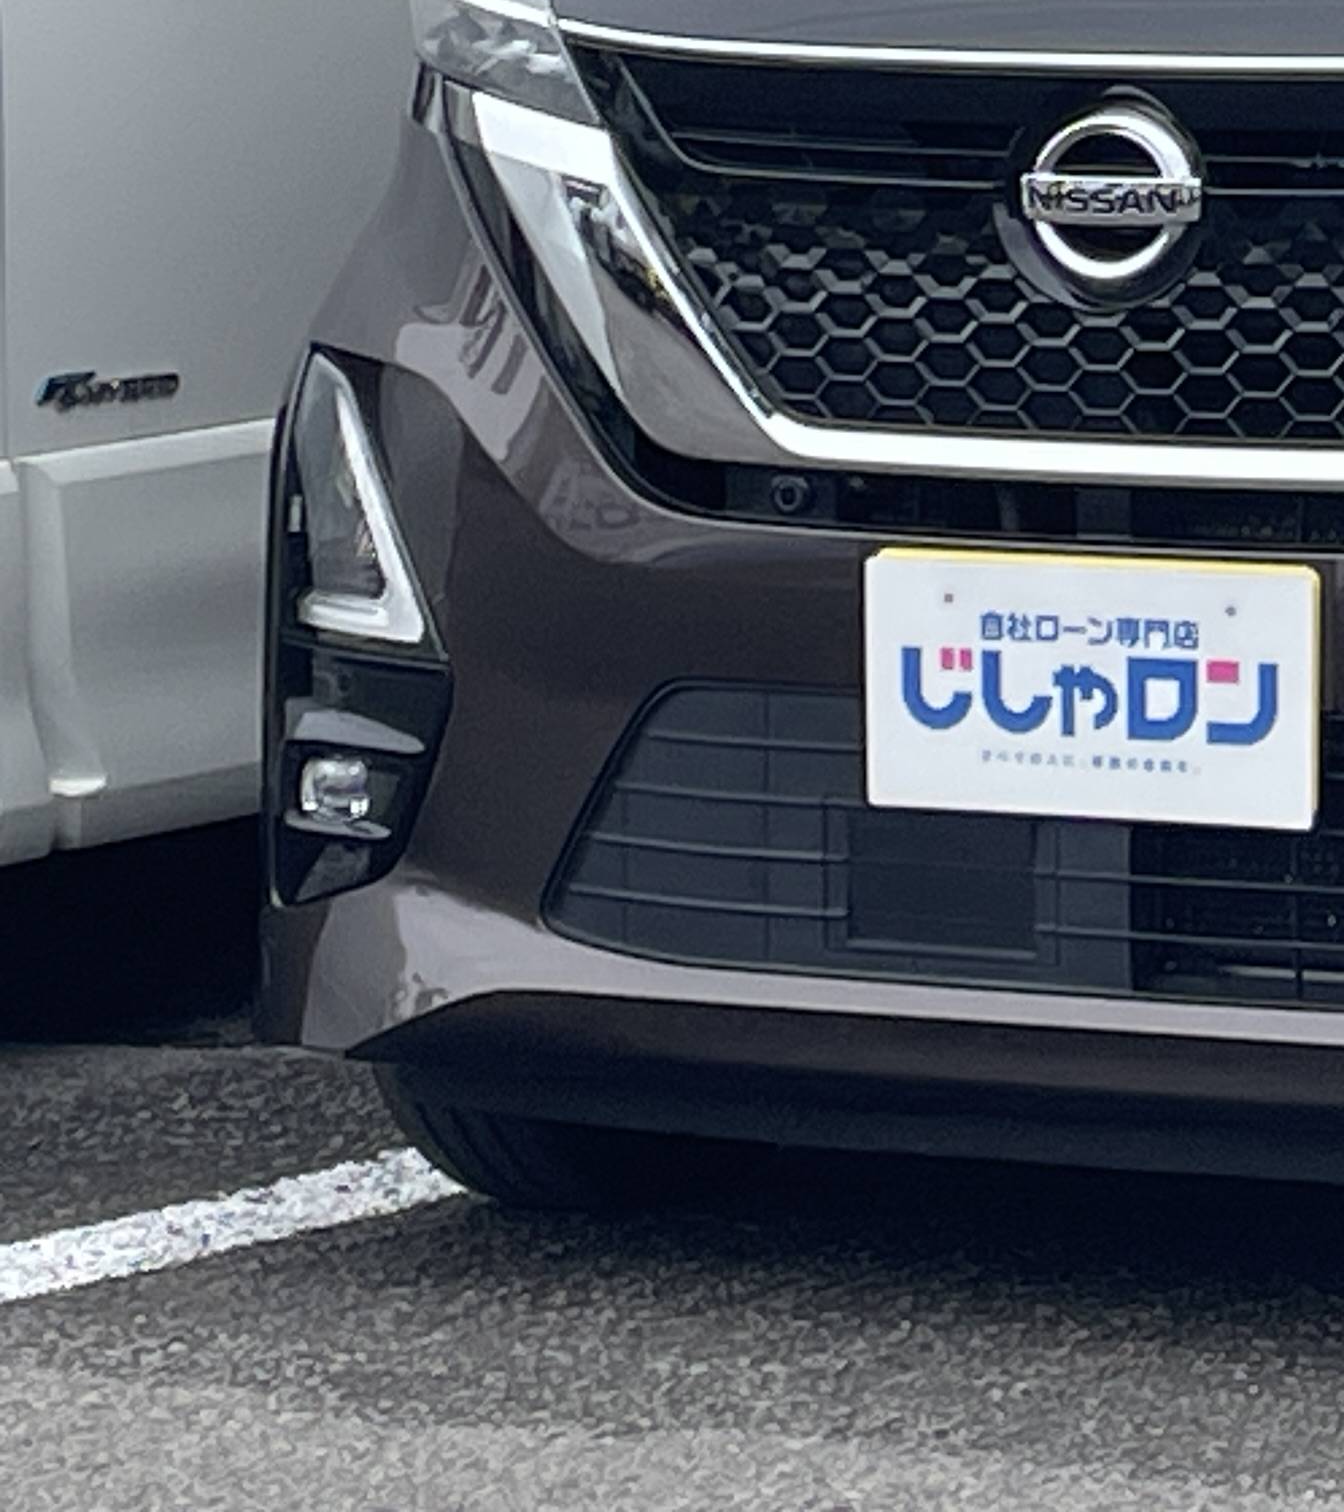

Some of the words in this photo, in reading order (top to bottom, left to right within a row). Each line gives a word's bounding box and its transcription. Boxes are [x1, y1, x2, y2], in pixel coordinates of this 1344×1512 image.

[1028, 179, 1178, 214] NISSAN
[980, 611, 1200, 650] 自社ローン専門店
[901, 646, 1279, 746] じしゃロン
